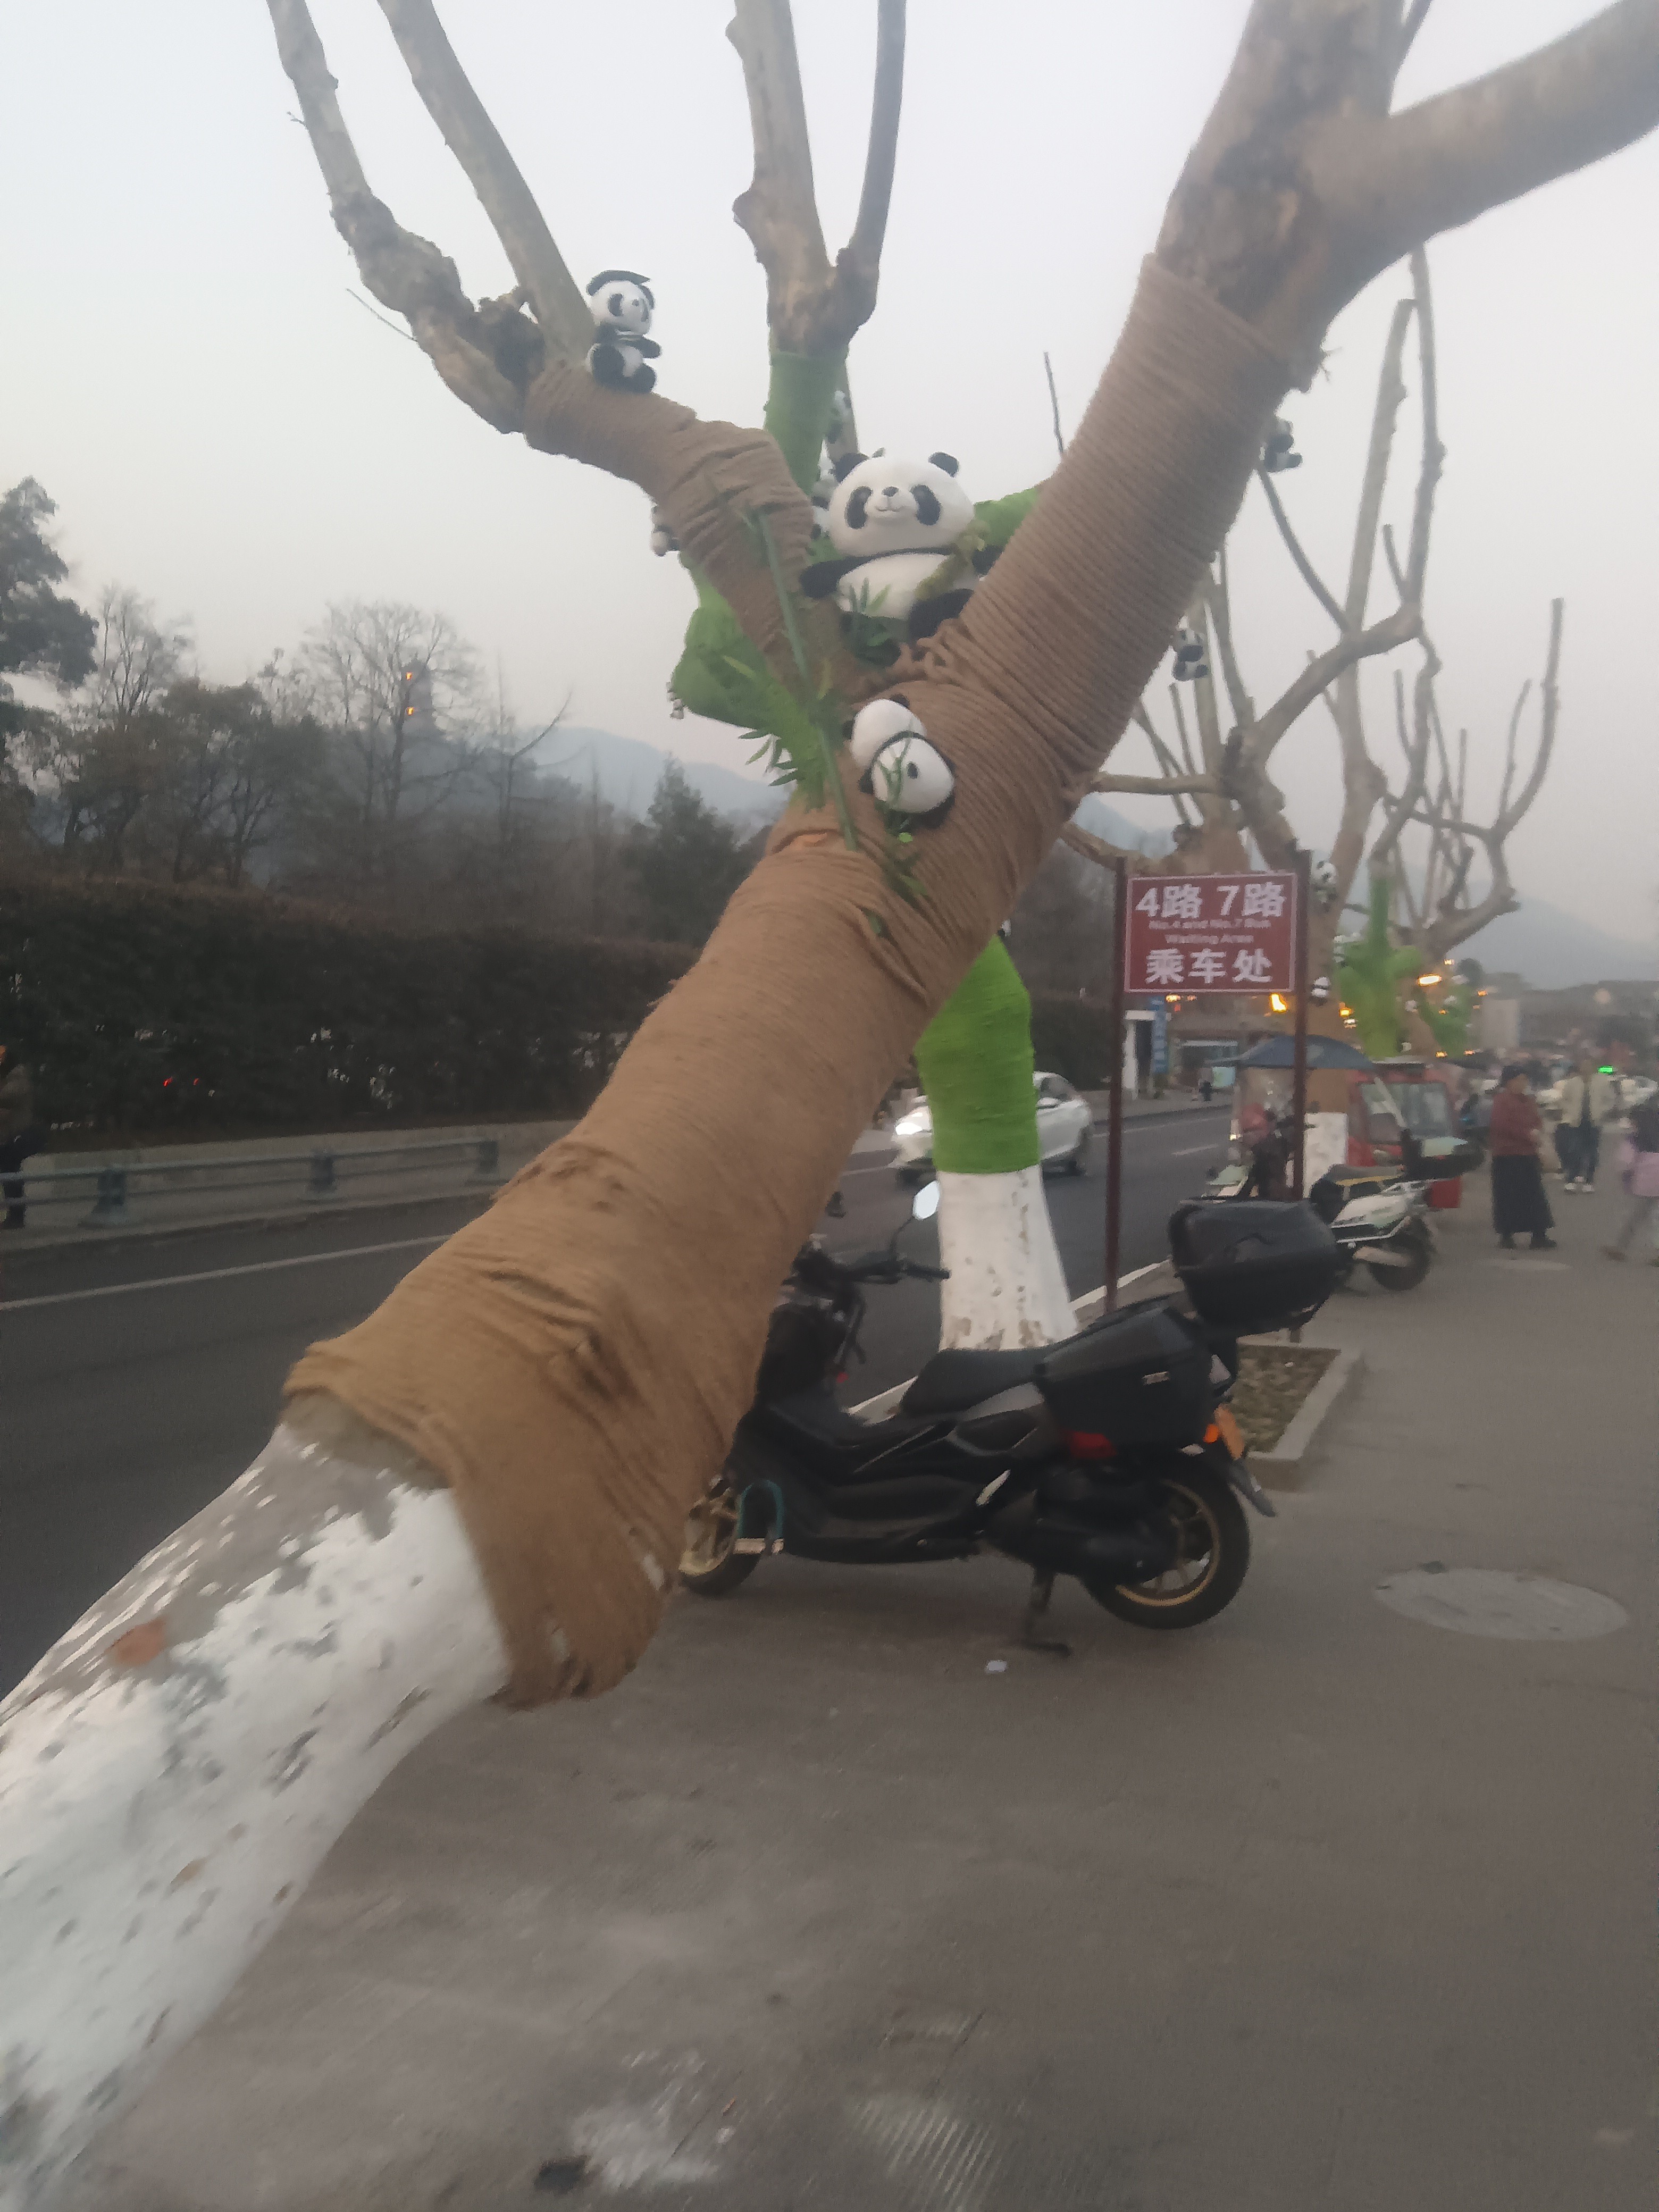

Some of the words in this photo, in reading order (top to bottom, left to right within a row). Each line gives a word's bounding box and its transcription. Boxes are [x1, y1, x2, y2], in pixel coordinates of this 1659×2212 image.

[1135, 884, 1203, 918] 4路
[1217, 882, 1286, 917] 7路
[1145, 948, 1272, 984] 乘车处
